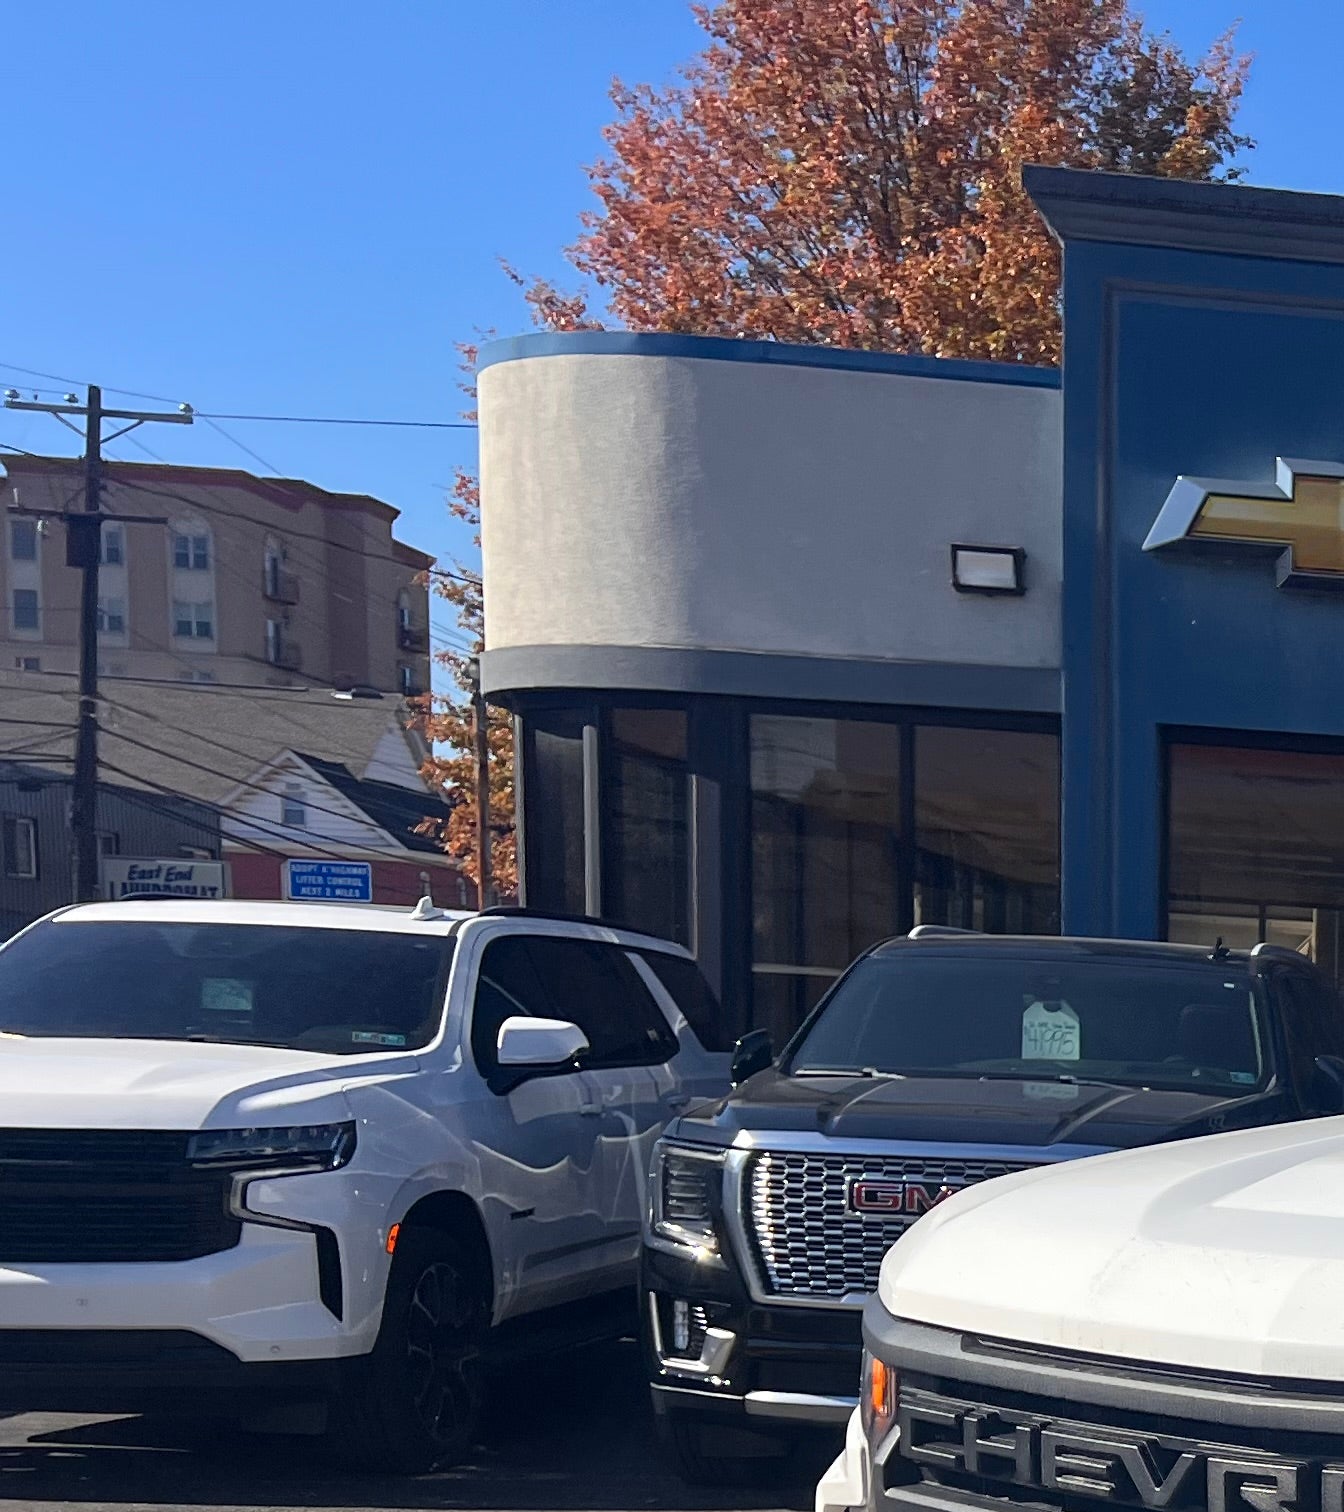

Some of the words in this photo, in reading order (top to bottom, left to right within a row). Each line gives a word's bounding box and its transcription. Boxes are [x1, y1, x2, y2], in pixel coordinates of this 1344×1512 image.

[127, 864, 162, 881] East
[164, 866, 194, 882] End
[295, 875, 324, 885] LITTER
[326, 876, 364, 887] CONTROL
[300, 886, 323, 896] NEXT
[853, 1182, 961, 1212] GM
